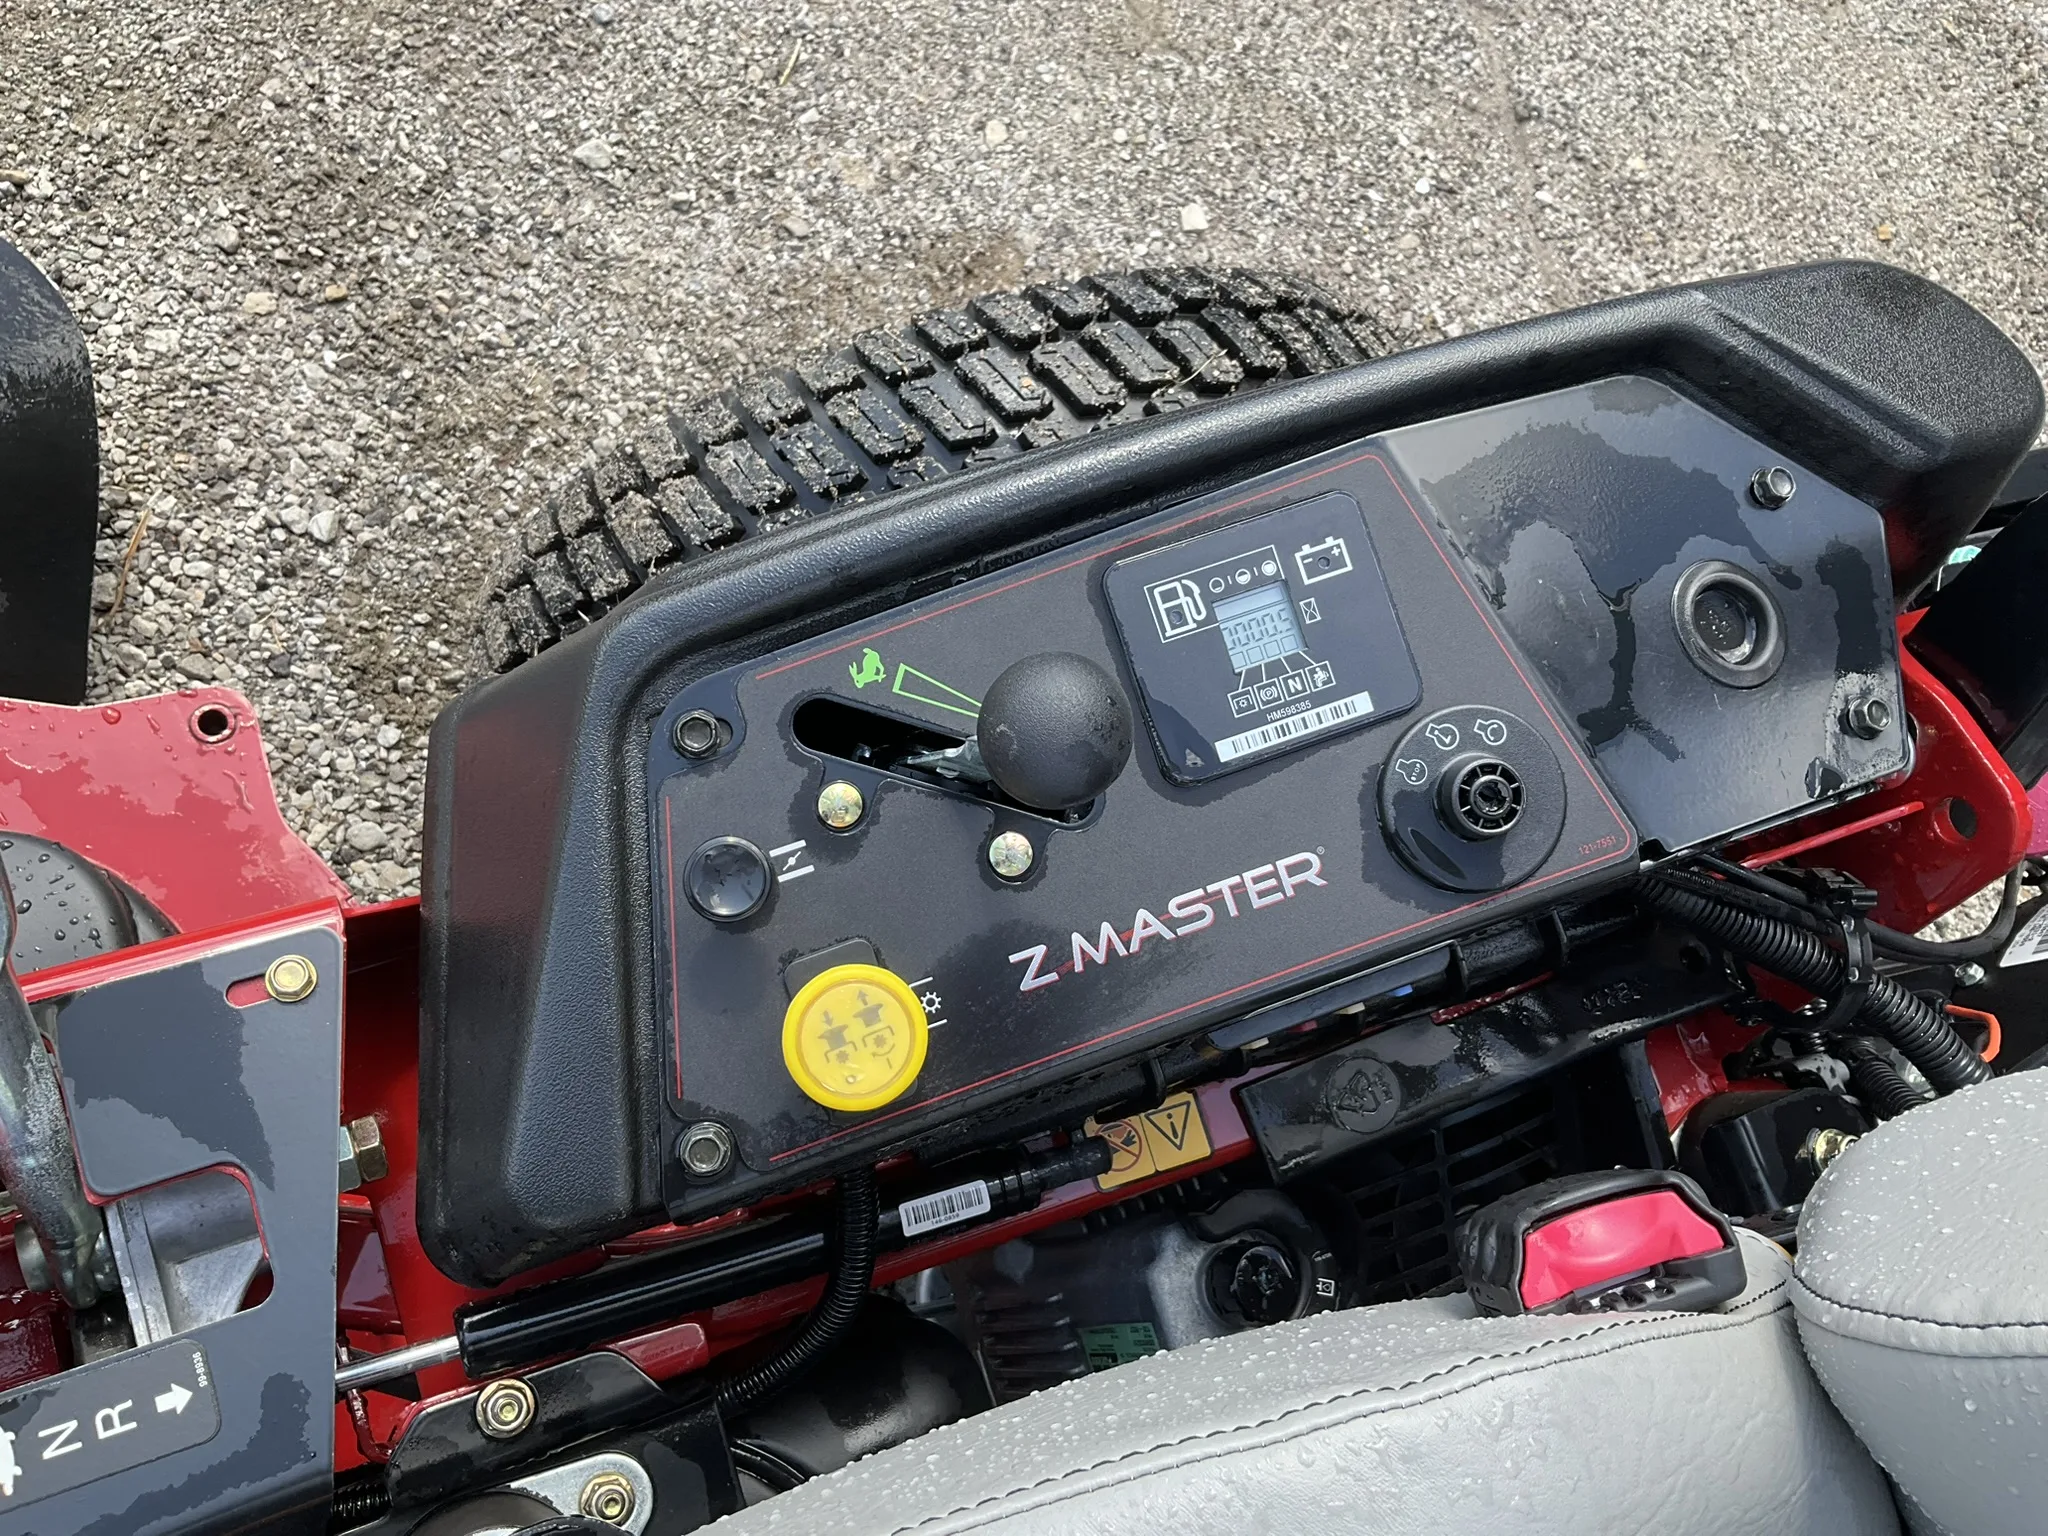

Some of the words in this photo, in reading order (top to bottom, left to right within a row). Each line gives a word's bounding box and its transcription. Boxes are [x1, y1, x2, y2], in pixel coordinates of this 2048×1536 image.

[1287, 676, 1303, 694] N
[1266, 699, 1312, 722] HM598385
[1410, 762, 1421, 782] STOP
[1008, 943, 1060, 993] Z
[1071, 851, 1329, 975] MASTER
[94, 1398, 138, 1440] R
[37, 1419, 83, 1461] N
